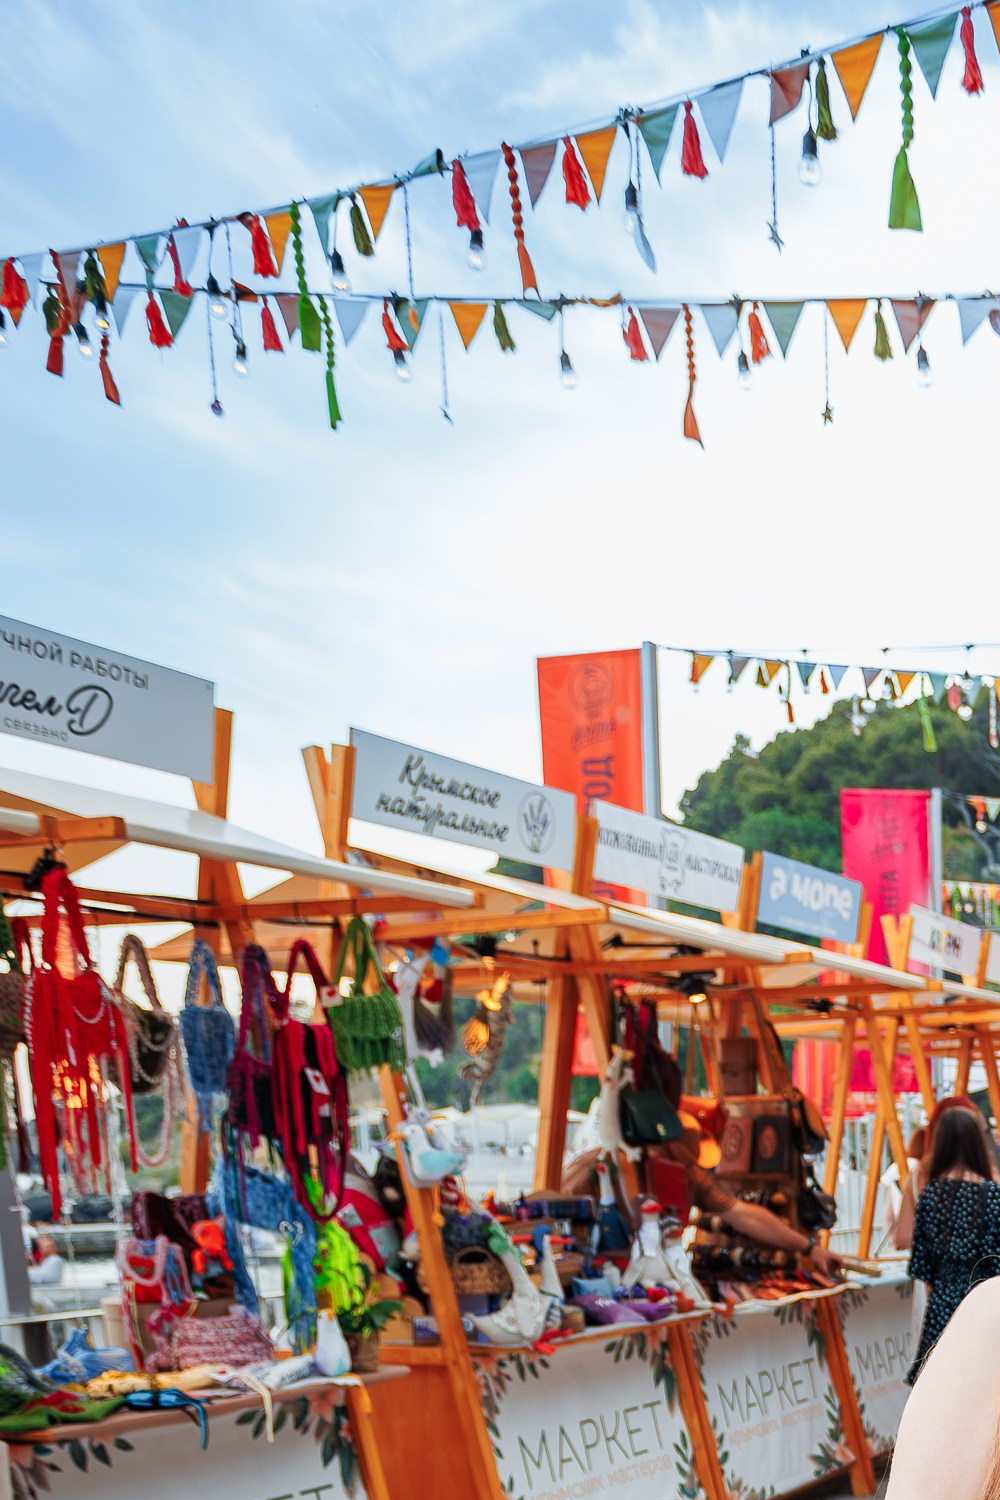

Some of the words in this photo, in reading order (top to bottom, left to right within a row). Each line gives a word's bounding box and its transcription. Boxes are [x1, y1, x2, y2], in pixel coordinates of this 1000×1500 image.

[0, 628, 63, 664] ЧНОЙ
[70, 650, 149, 690] РАБОТЫ
[0, 680, 62, 717] гел
[399, 753, 501, 808] Крымское
[375, 792, 510, 841] натуральное
[717, 1357, 818, 1428] МАРКЕТ
[517, 1400, 664, 1489] МАРКЕТ
[607, 1455, 673, 1487] мастеров
